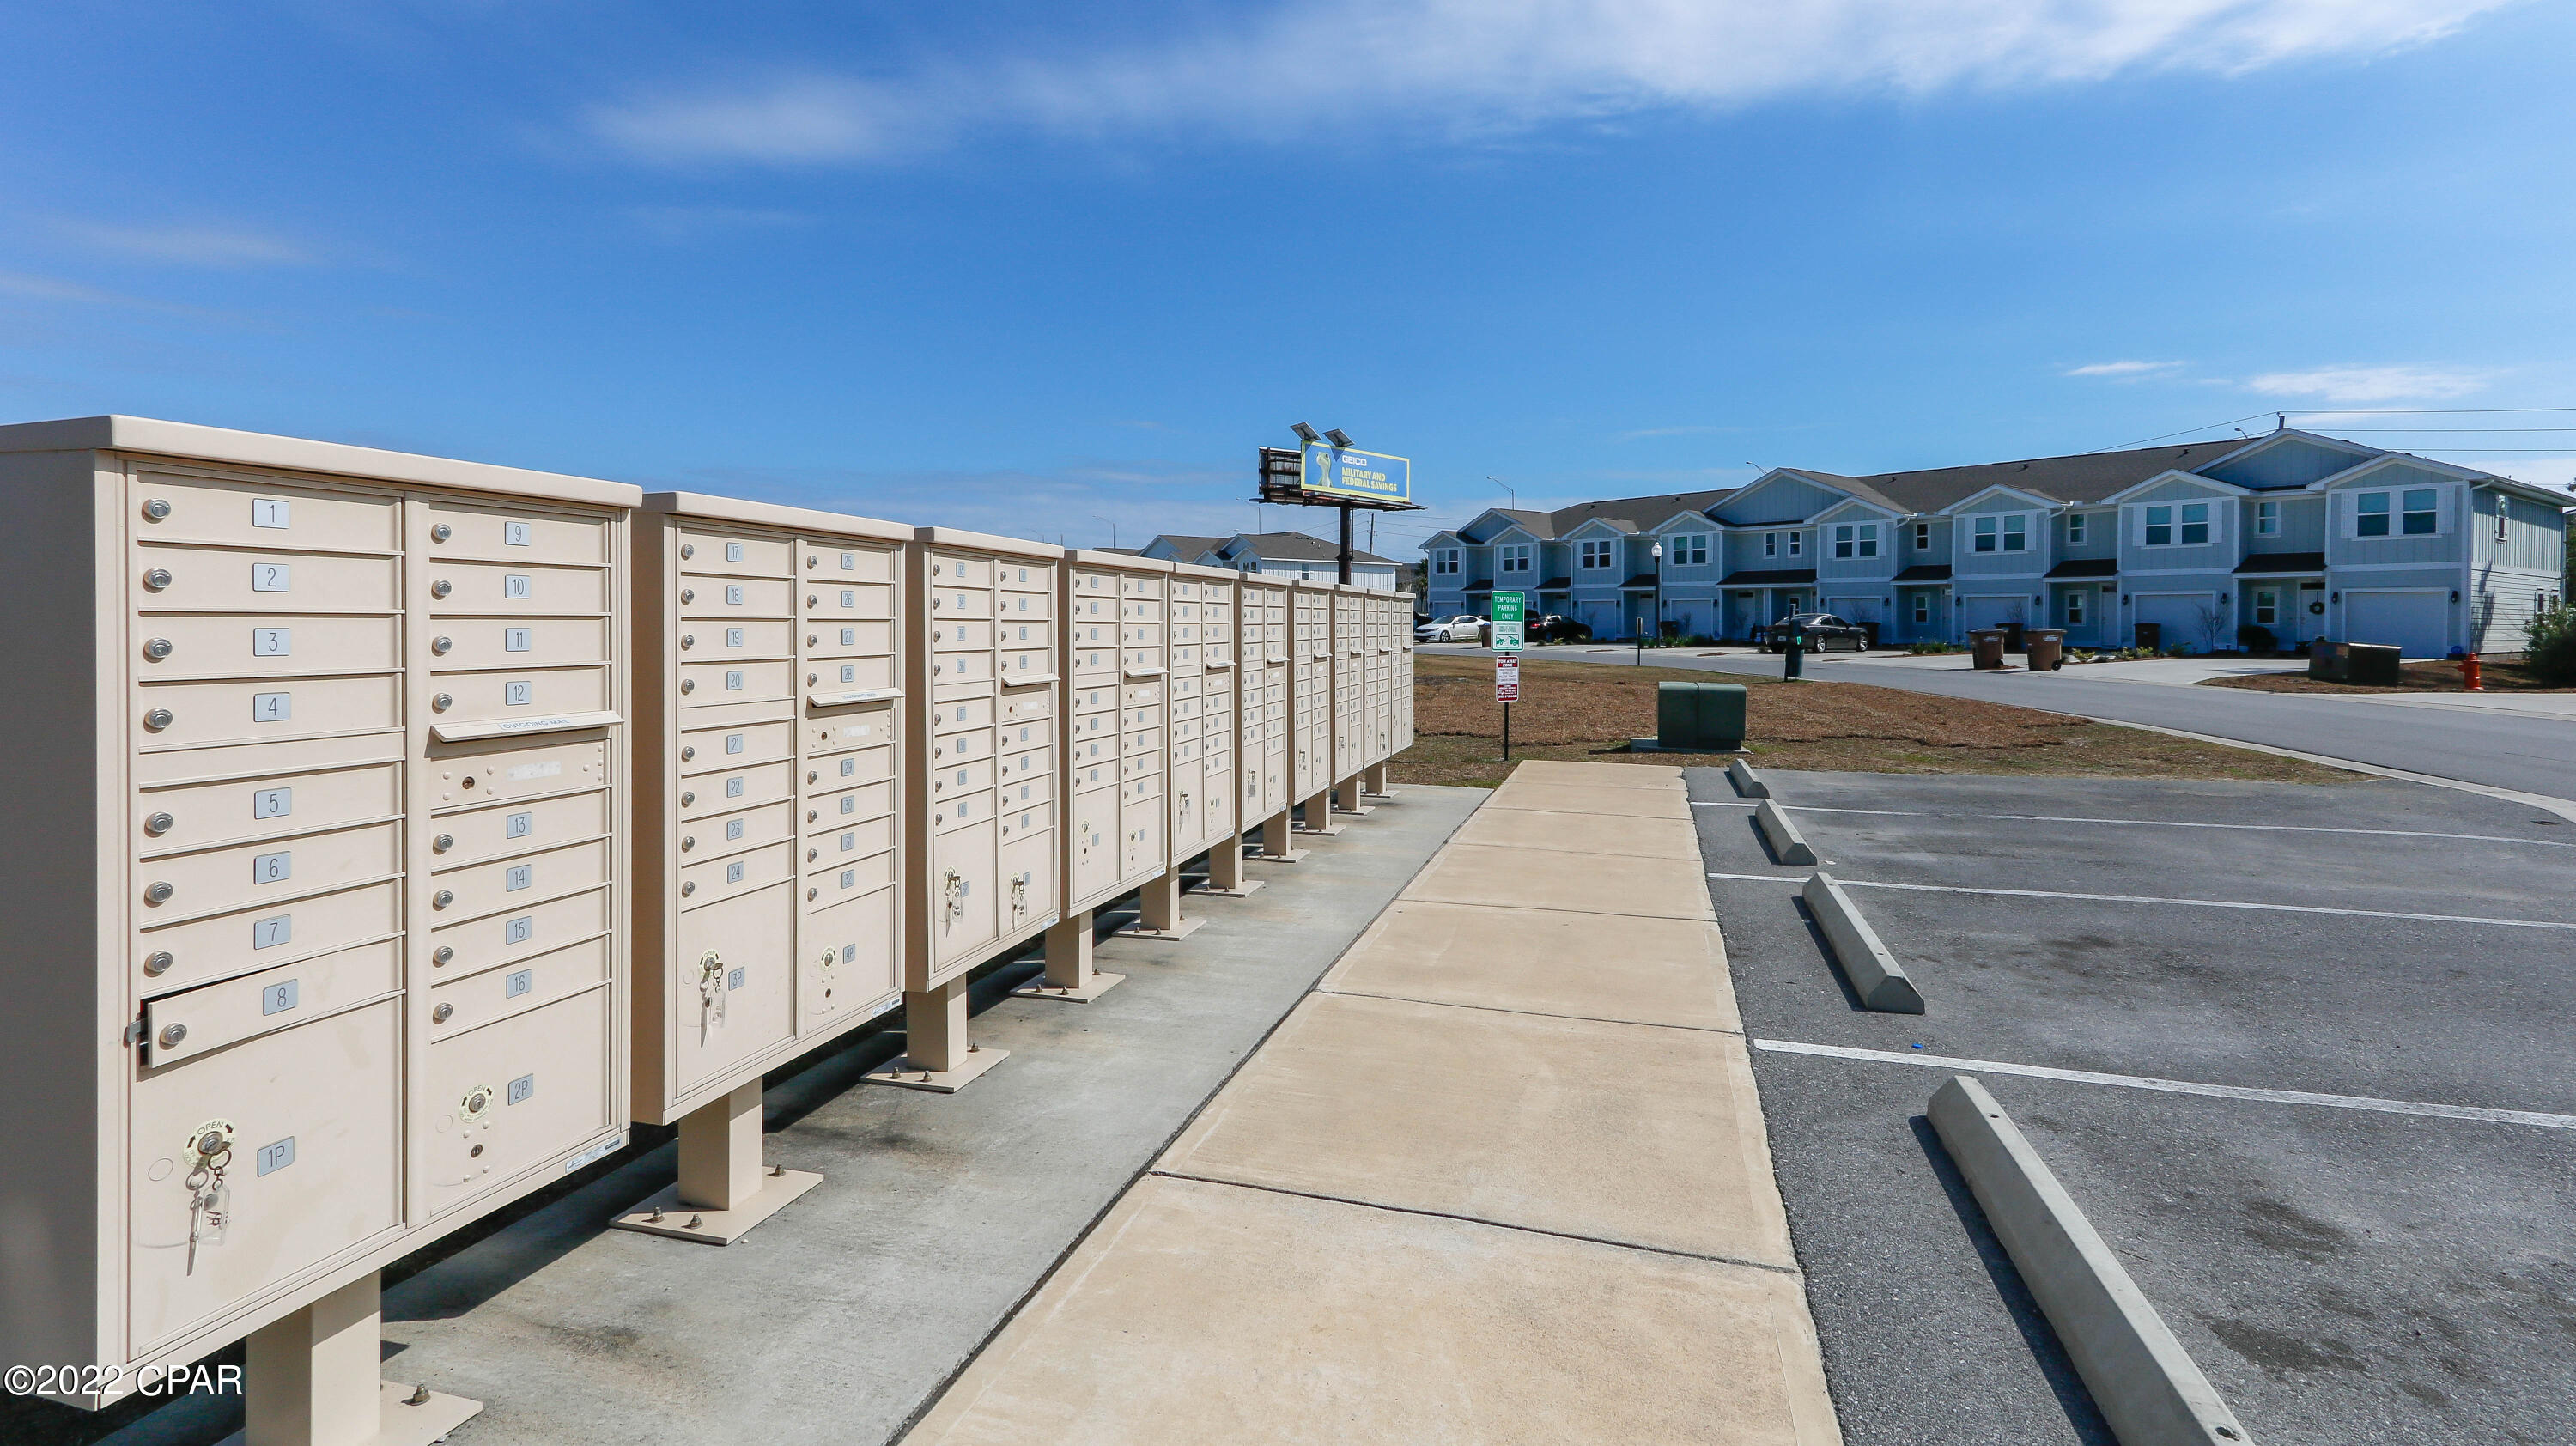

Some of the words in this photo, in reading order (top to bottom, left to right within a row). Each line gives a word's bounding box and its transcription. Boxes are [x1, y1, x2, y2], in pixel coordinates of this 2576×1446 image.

[1342, 455, 1367, 466] GEICO
[1342, 467, 1371, 479] MILITARY
[1372, 472, 1386, 481] AND
[1342, 477, 1370, 488] FEDERAL
[1371, 481, 1397, 492] SAVINGS
[270, 505, 275, 522] 1
[515, 526, 521, 542] 9
[732, 546, 739, 558] 17
[844, 556, 852, 568] 25
[268, 568, 276, 586] 2
[513, 579, 524, 595] 10
[732, 588, 739, 601] 18
[845, 593, 852, 605] 26
[269, 633, 277, 652] 3
[515, 632, 523, 647] 11
[732, 631, 739, 644] 19
[845, 631, 852, 642] 27
[731, 674, 740, 687] 20
[845, 668, 852, 679] 28
[514, 685, 524, 701] 12
[269, 698, 277, 715] 4
[502, 720, 548, 729] OUTGOING
[732, 738, 738, 750] 21
[845, 762, 852, 774] 29
[732, 781, 739, 794] 22
[270, 794, 278, 812] 5
[845, 799, 852, 811] 30
[515, 817, 525, 834] 13
[732, 823, 740, 836] 23
[846, 835, 852, 848] 31
[270, 859, 278, 877] 6
[732, 866, 740, 879] 24
[515, 870, 524, 885] 14
[845, 873, 852, 885] 32
[270, 922, 277, 941] 7
[515, 922, 525, 938] 15
[847, 948, 853, 959] 4P
[515, 975, 525, 992] 16
[733, 971, 741, 987] 3P
[277, 987, 286, 1007] 8
[469, 1085, 486, 1096] OPEN
[515, 1080, 528, 1099] 2P
[197, 1121, 224, 1135] OPEN
[269, 1145, 284, 1167] 1P
